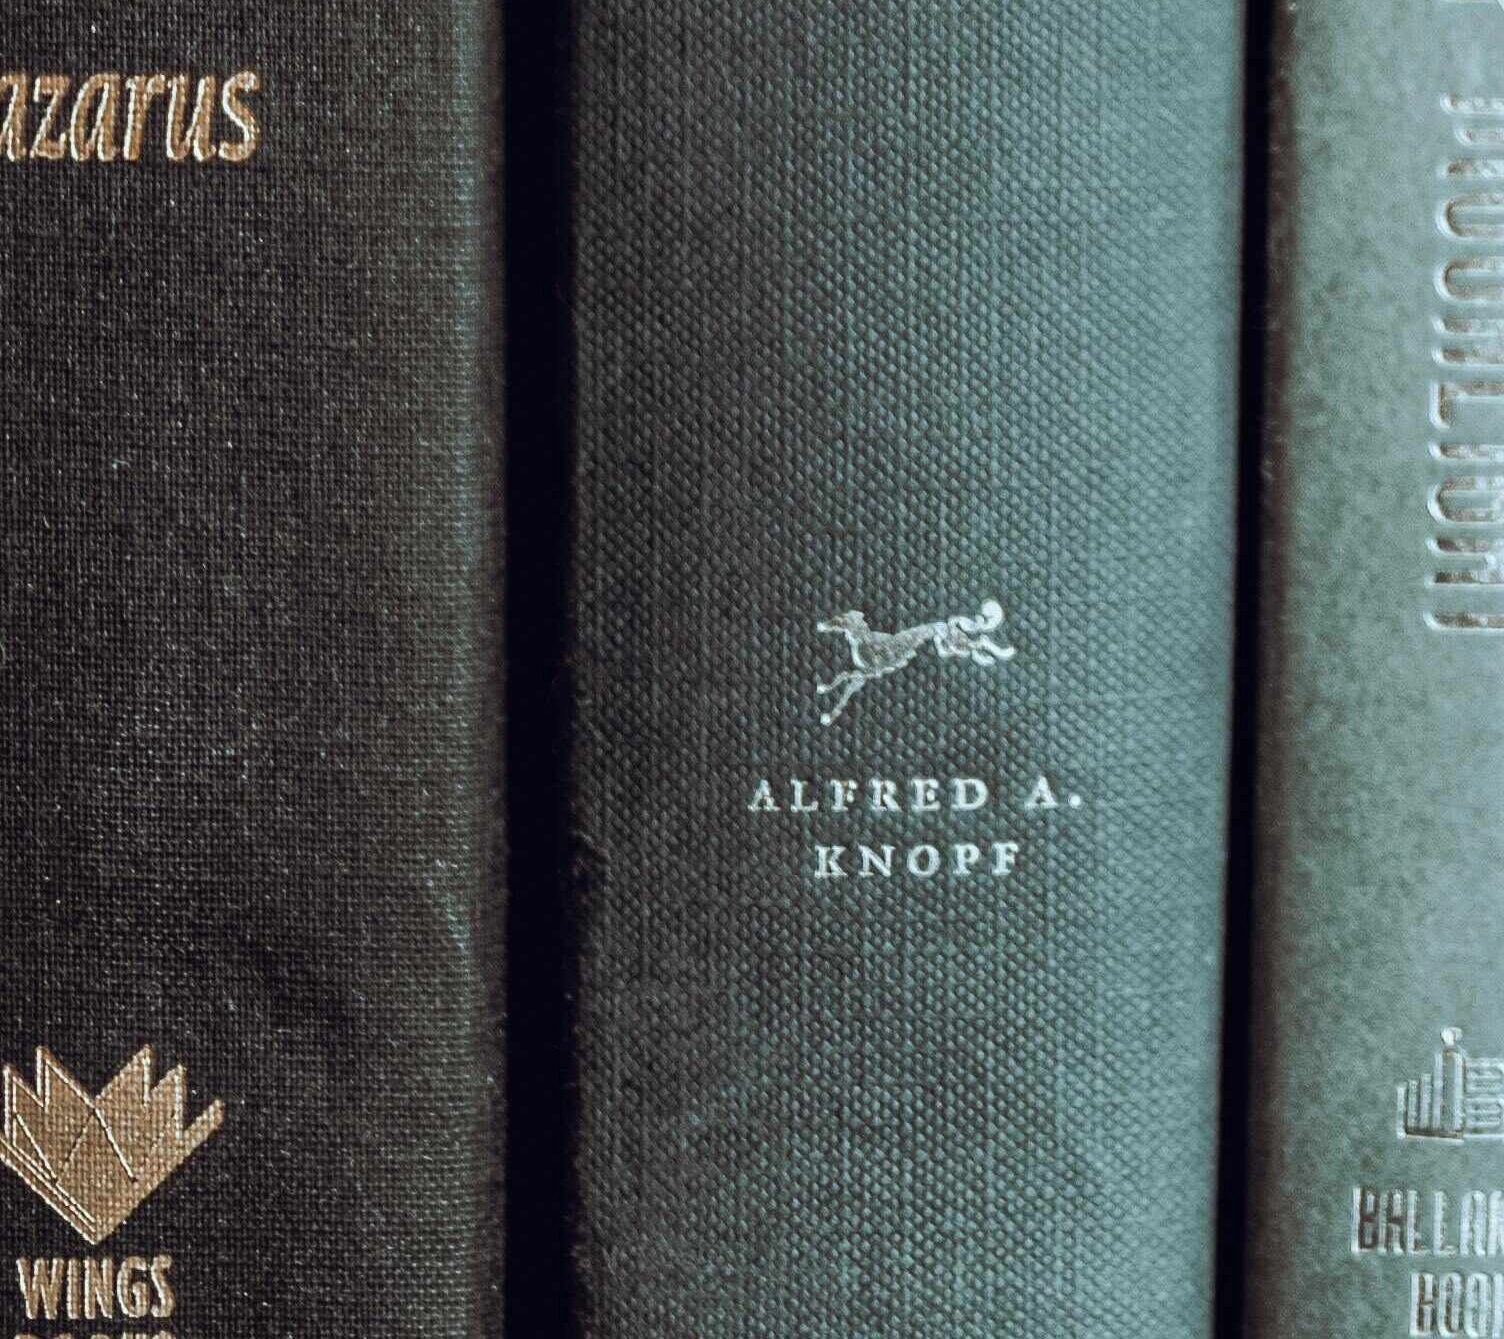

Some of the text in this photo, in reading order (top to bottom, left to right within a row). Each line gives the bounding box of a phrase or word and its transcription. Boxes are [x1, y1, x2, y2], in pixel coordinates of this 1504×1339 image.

[747, 774, 1084, 813] ALFRED A.
[813, 841, 1020, 879] KNOPF
[15, 1254, 177, 1320] WINGS
